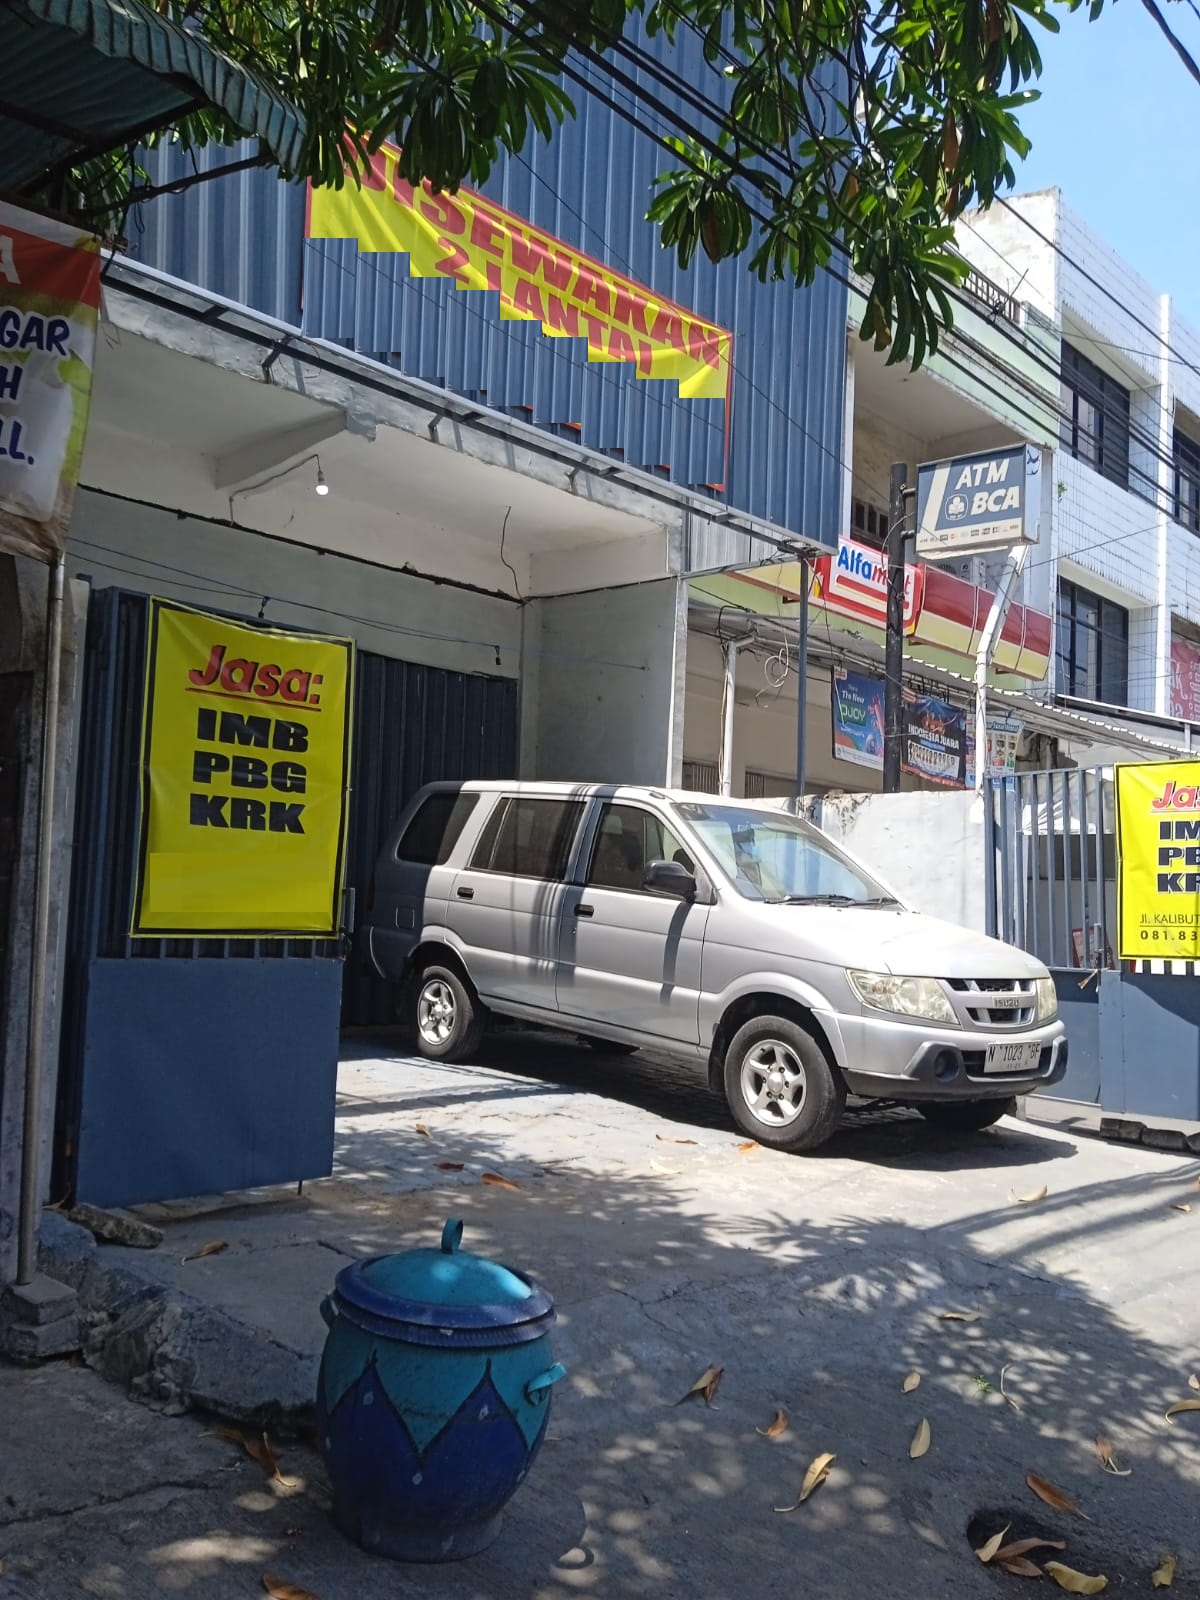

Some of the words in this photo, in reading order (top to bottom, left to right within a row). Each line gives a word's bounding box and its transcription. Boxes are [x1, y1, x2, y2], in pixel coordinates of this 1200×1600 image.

[434, 236, 472, 284] 2
[486, 260, 653, 376] LANTAI
[954, 458, 1009, 490] ATM
[970, 486, 1019, 515] BCA
[188, 645, 324, 705] Jasa:
[196, 707, 309, 753] IMB
[940, 735, 960, 750] JUARA
[192, 749, 307, 794] PBG
[1152, 781, 1200, 809] Ja
[189, 793, 306, 834] KRK
[994, 999, 1019, 1008] ISUZU
[988, 1045, 995, 1063] N
[1003, 1045, 1023, 1062] 1023
